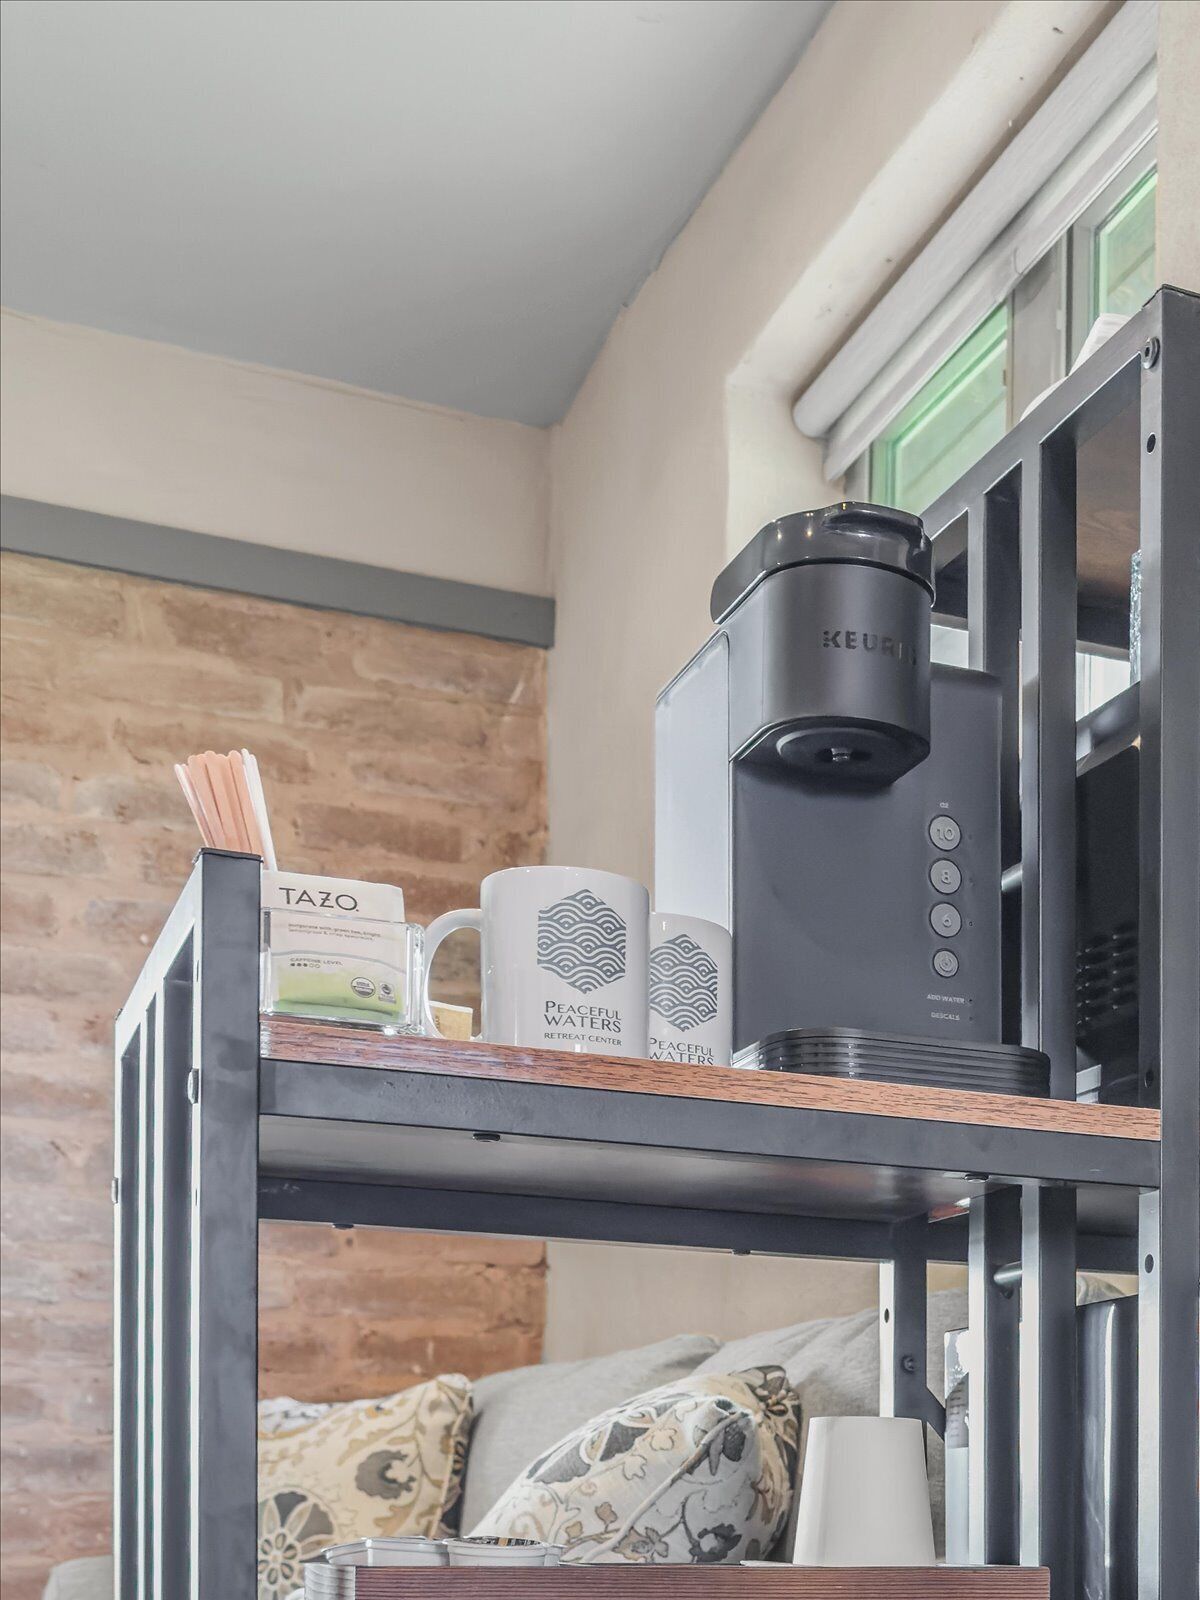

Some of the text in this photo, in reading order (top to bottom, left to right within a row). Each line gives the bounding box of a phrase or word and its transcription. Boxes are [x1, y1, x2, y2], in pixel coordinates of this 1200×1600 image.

[936, 827, 955, 842] 10
[940, 868, 952, 885] 8
[941, 912, 952, 928] 6
[545, 1000, 622, 1021] PEACEFUL
[543, 1013, 622, 1034] WATERS
[544, 1032, 622, 1046] RETREAT CENTER
